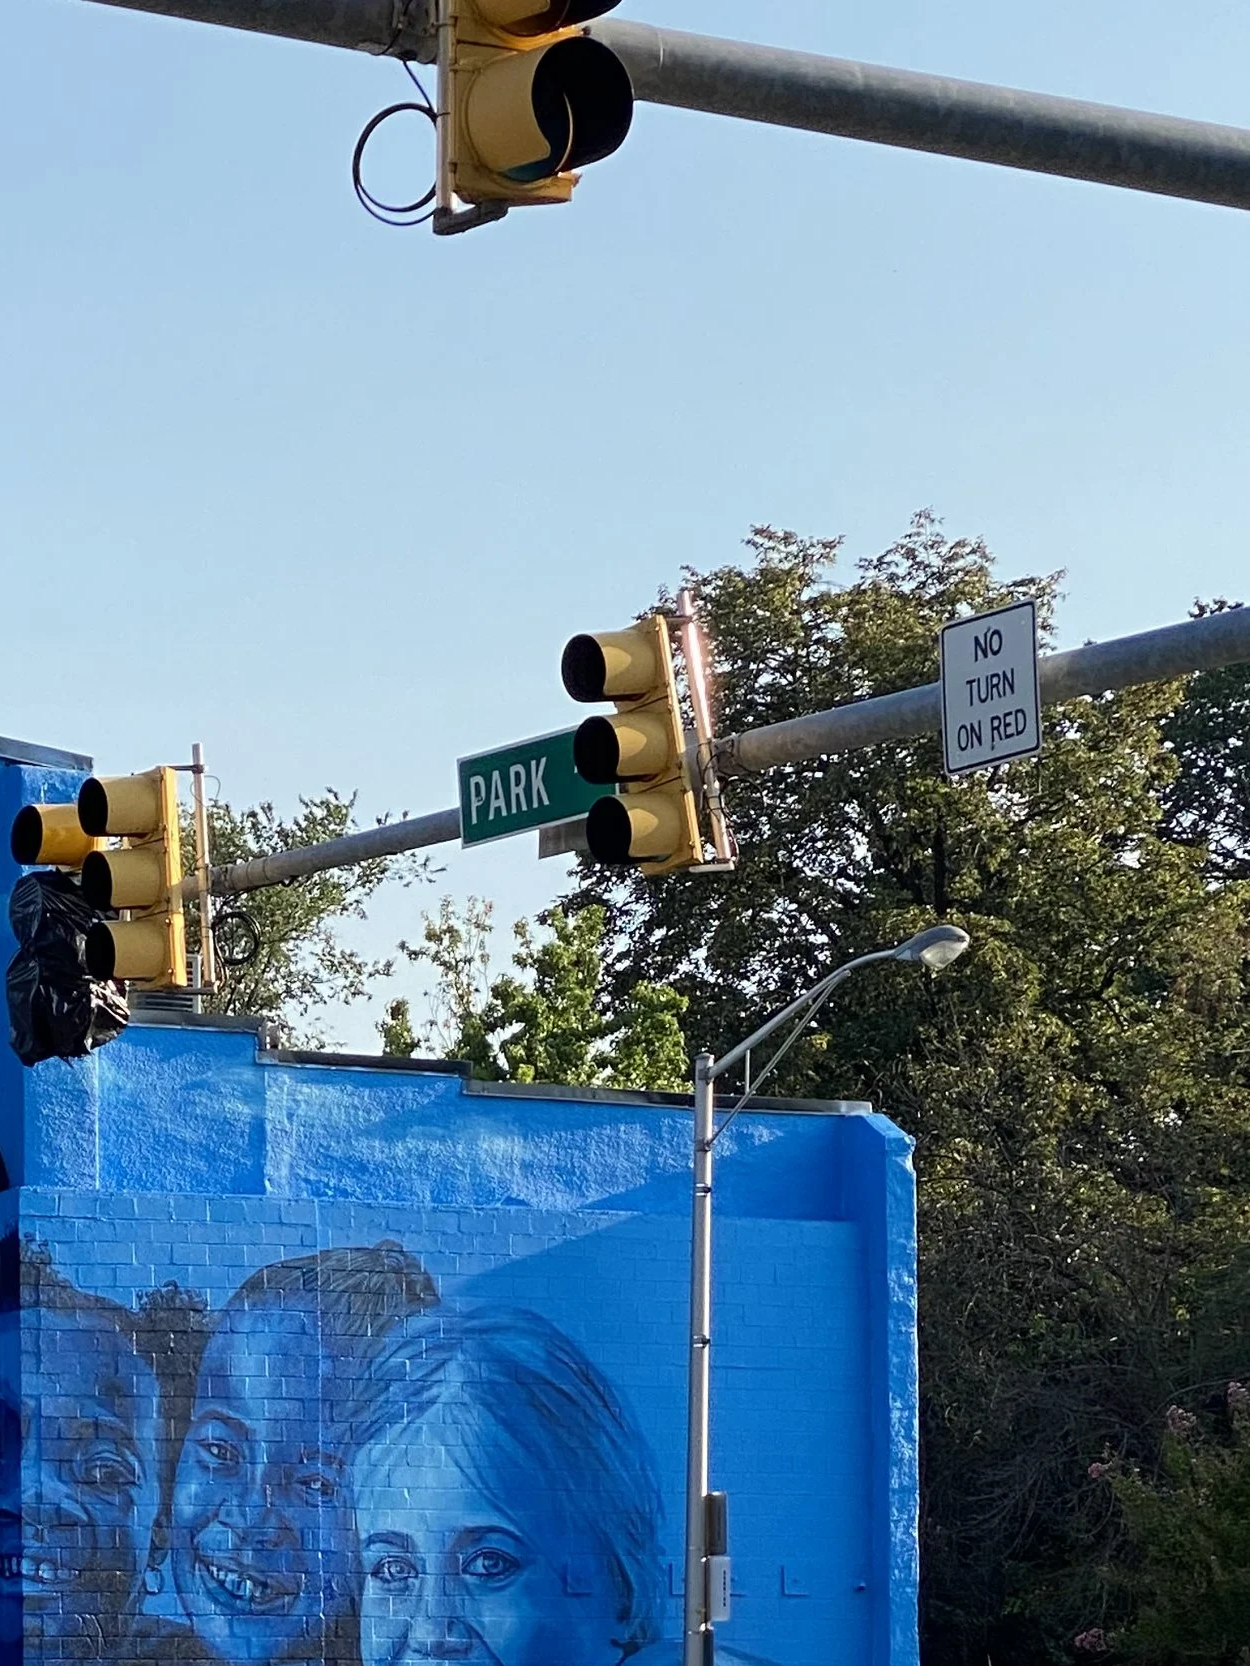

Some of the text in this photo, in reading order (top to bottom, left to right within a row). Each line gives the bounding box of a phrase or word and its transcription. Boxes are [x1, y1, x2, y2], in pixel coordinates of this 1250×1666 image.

[974, 627, 1003, 663] NO
[966, 668, 1015, 707] TURN
[957, 708, 1027, 751] ON RED
[469, 756, 550, 825] PARK
